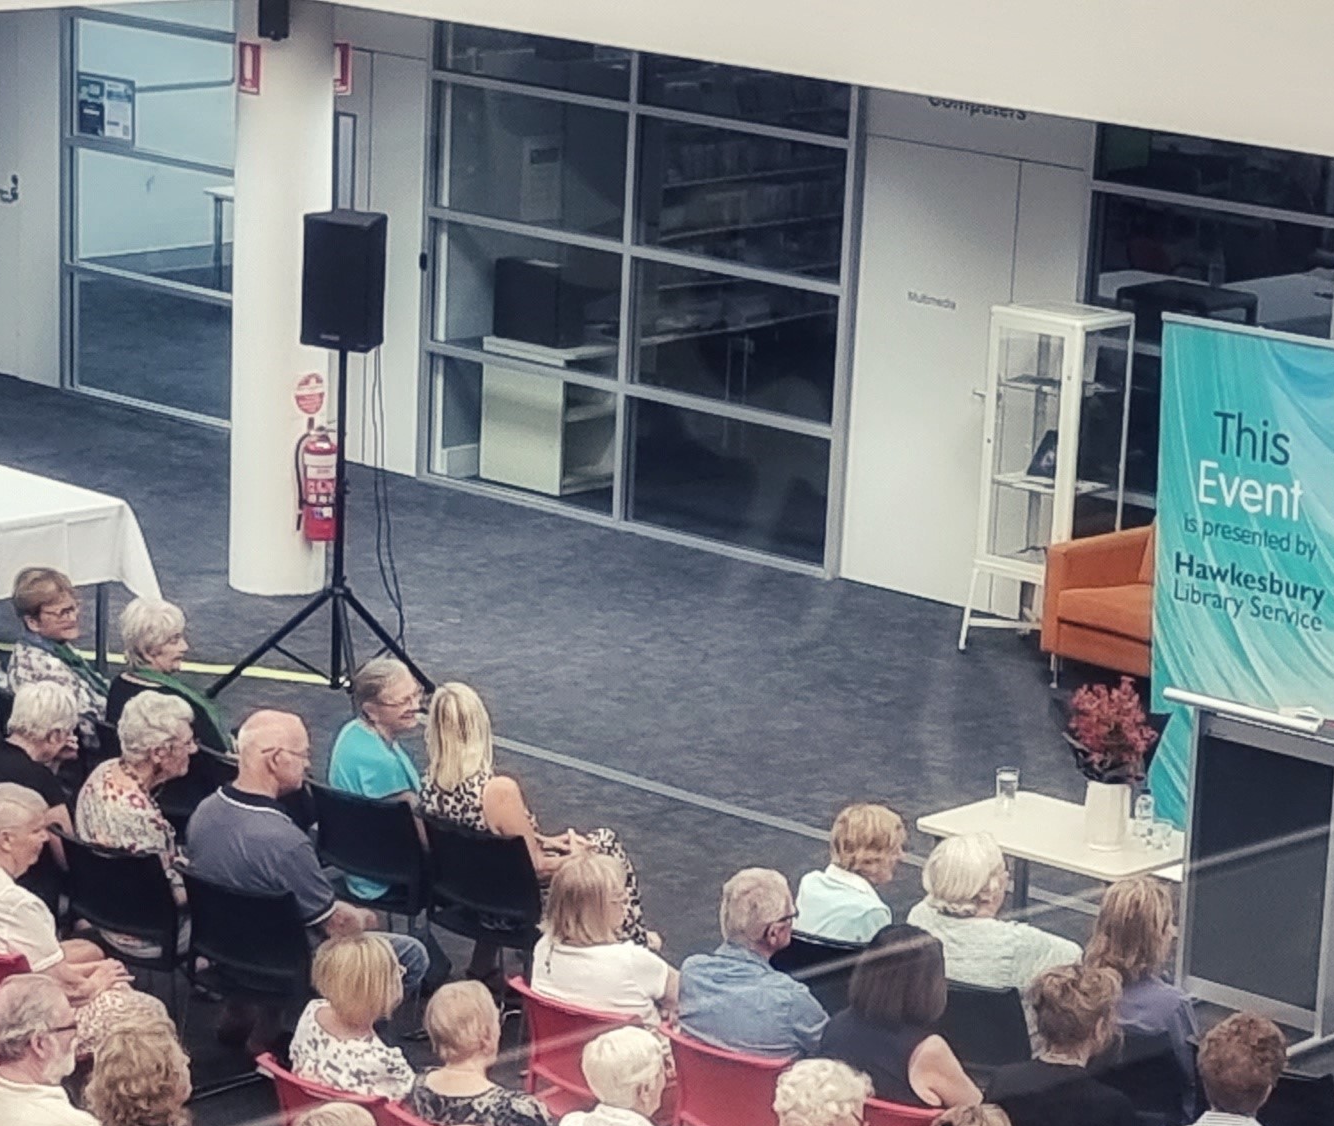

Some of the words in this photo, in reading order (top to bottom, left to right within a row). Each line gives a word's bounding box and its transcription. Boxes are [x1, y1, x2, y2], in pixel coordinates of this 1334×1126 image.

[1213, 411, 1291, 467] This
[1198, 459, 1304, 521] Event
[1184, 512, 1197, 533] is
[1202, 520, 1291, 552] presented
[1296, 534, 1317, 563] by
[1173, 579, 1245, 619] Library
[1250, 596, 1324, 632] Service
[1174, 551, 1325, 611] Hawkesbury
